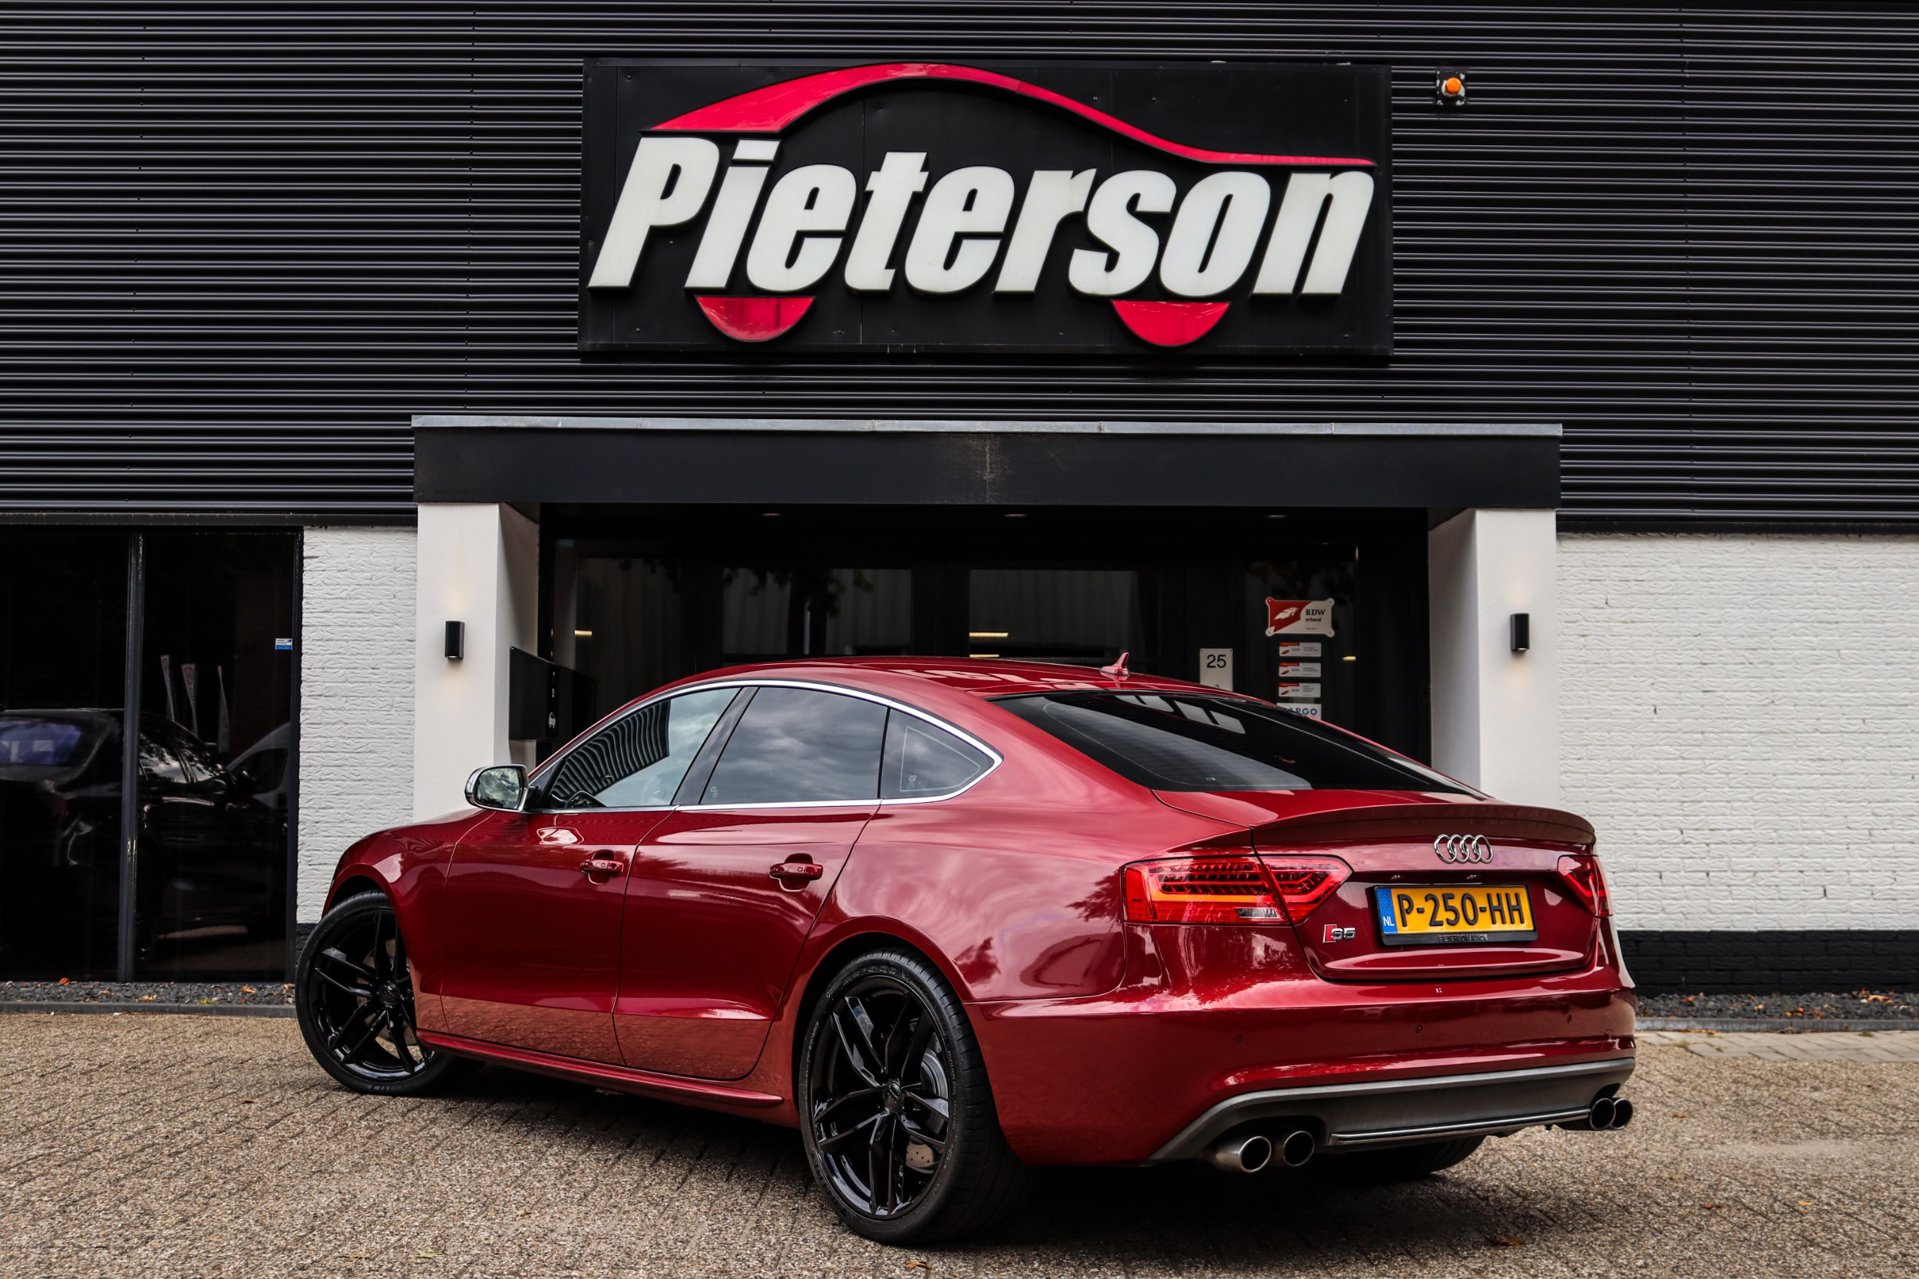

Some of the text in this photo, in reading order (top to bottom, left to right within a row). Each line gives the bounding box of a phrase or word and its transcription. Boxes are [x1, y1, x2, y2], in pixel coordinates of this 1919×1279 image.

[588, 137, 1375, 297] Pieterson
[1207, 654, 1226, 668] 25
[1383, 892, 1525, 927] NL P-250-HH
[1330, 927, 1356, 940] S5
